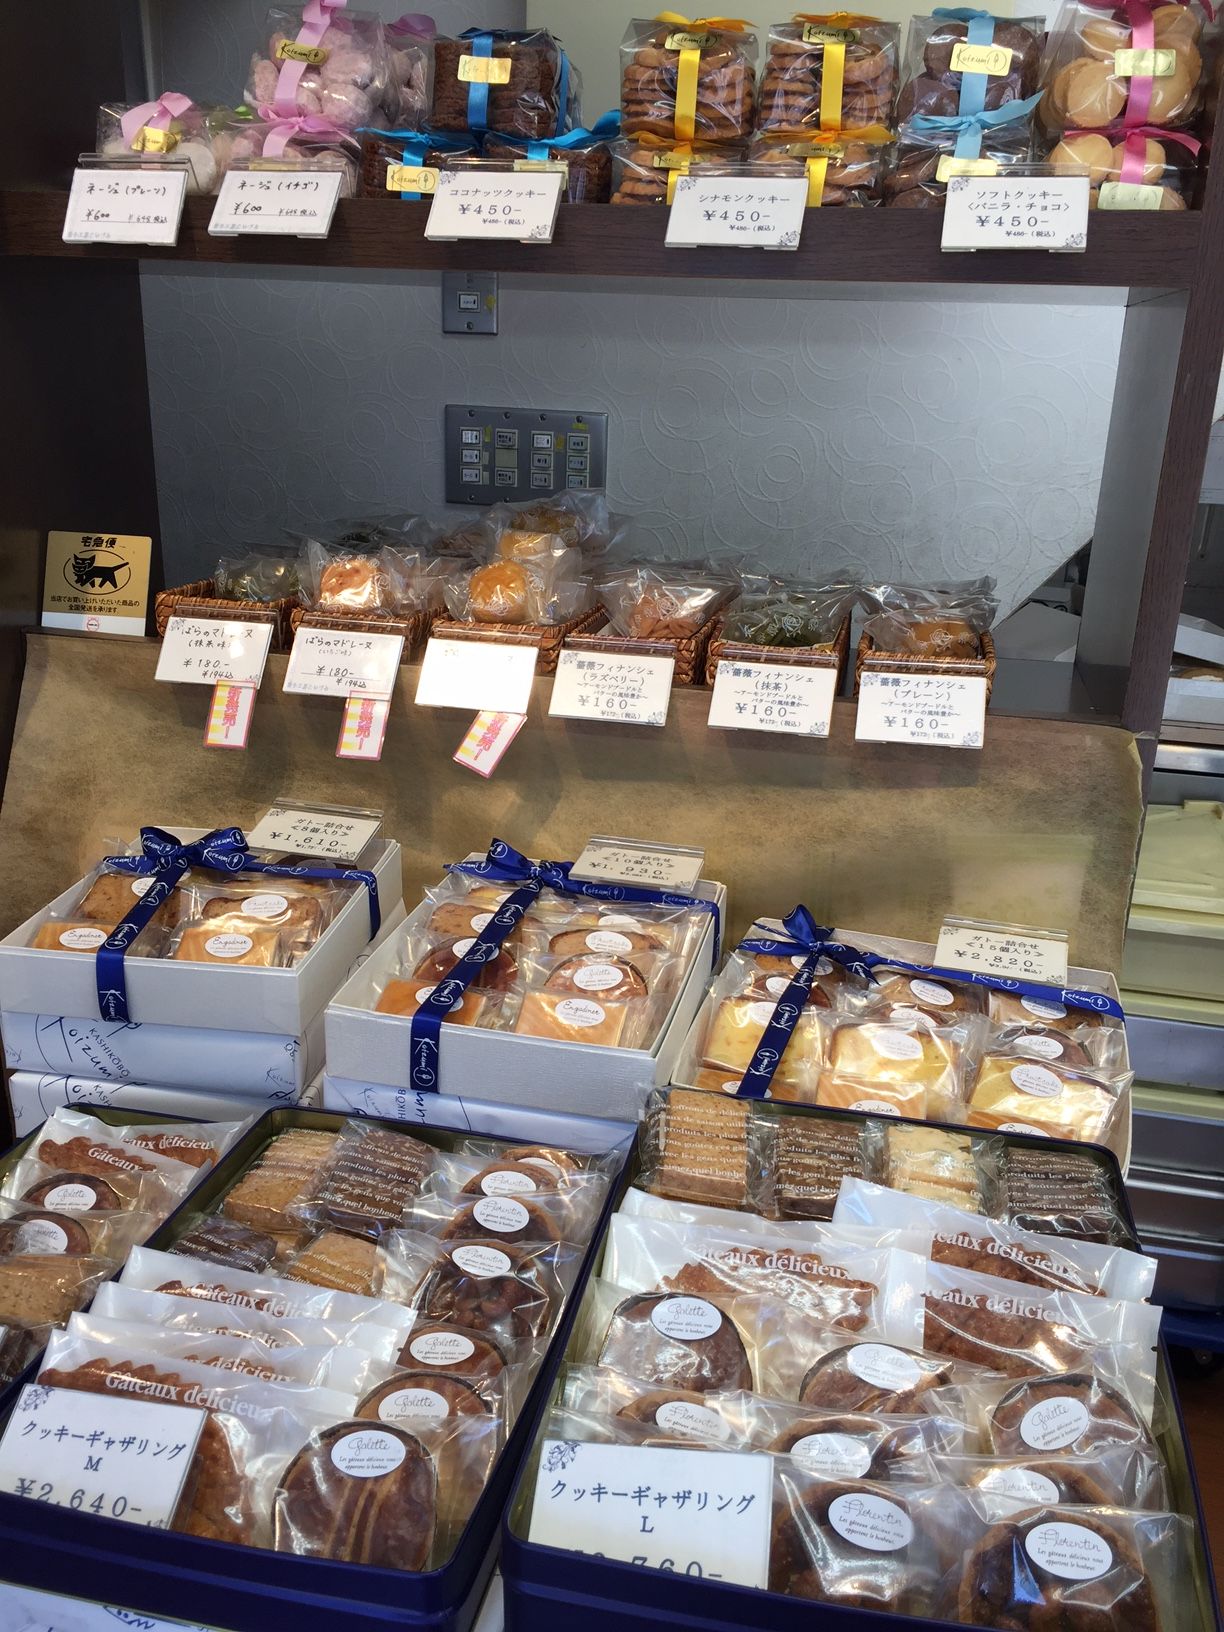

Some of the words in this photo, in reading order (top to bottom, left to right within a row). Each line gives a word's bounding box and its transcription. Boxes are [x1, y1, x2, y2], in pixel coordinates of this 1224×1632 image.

[449, 188, 546, 198] ココナッツクッキー
[698, 194, 790, 204] シナモンクッキー
[977, 191, 1063, 200] ソフトクッキー
[81, 536, 118, 548] 宅急便
[306, 635, 373, 649] ばらのマドレーヌ
[576, 660, 655, 676] 薔薇フィナンシェ
[731, 668, 815, 683] 薔薇フィナンシェ
[879, 677, 967, 691] 薔薇フィナンシェ
[663, 1126, 702, 1138] produits
[88, 1146, 143, 1172] Gâteaux
[338, 1160, 374, 1173] produits
[764, 1252, 851, 1280] délicieux
[987, 1238, 1079, 1281] délicieux
[667, 1303, 708, 1320] Galette
[105, 1370, 180, 1402] Gâteaux
[394, 1395, 436, 1413] Galette
[21, 1421, 188, 1461] クッキーギャザリング
[347, 1436, 391, 1456] Galette
[83, 1455, 101, 1471] M
[551, 1479, 756, 1515] クッキーギャザリング
[639, 1515, 655, 1533] L
[1038, 1528, 1102, 1553] Florentin
